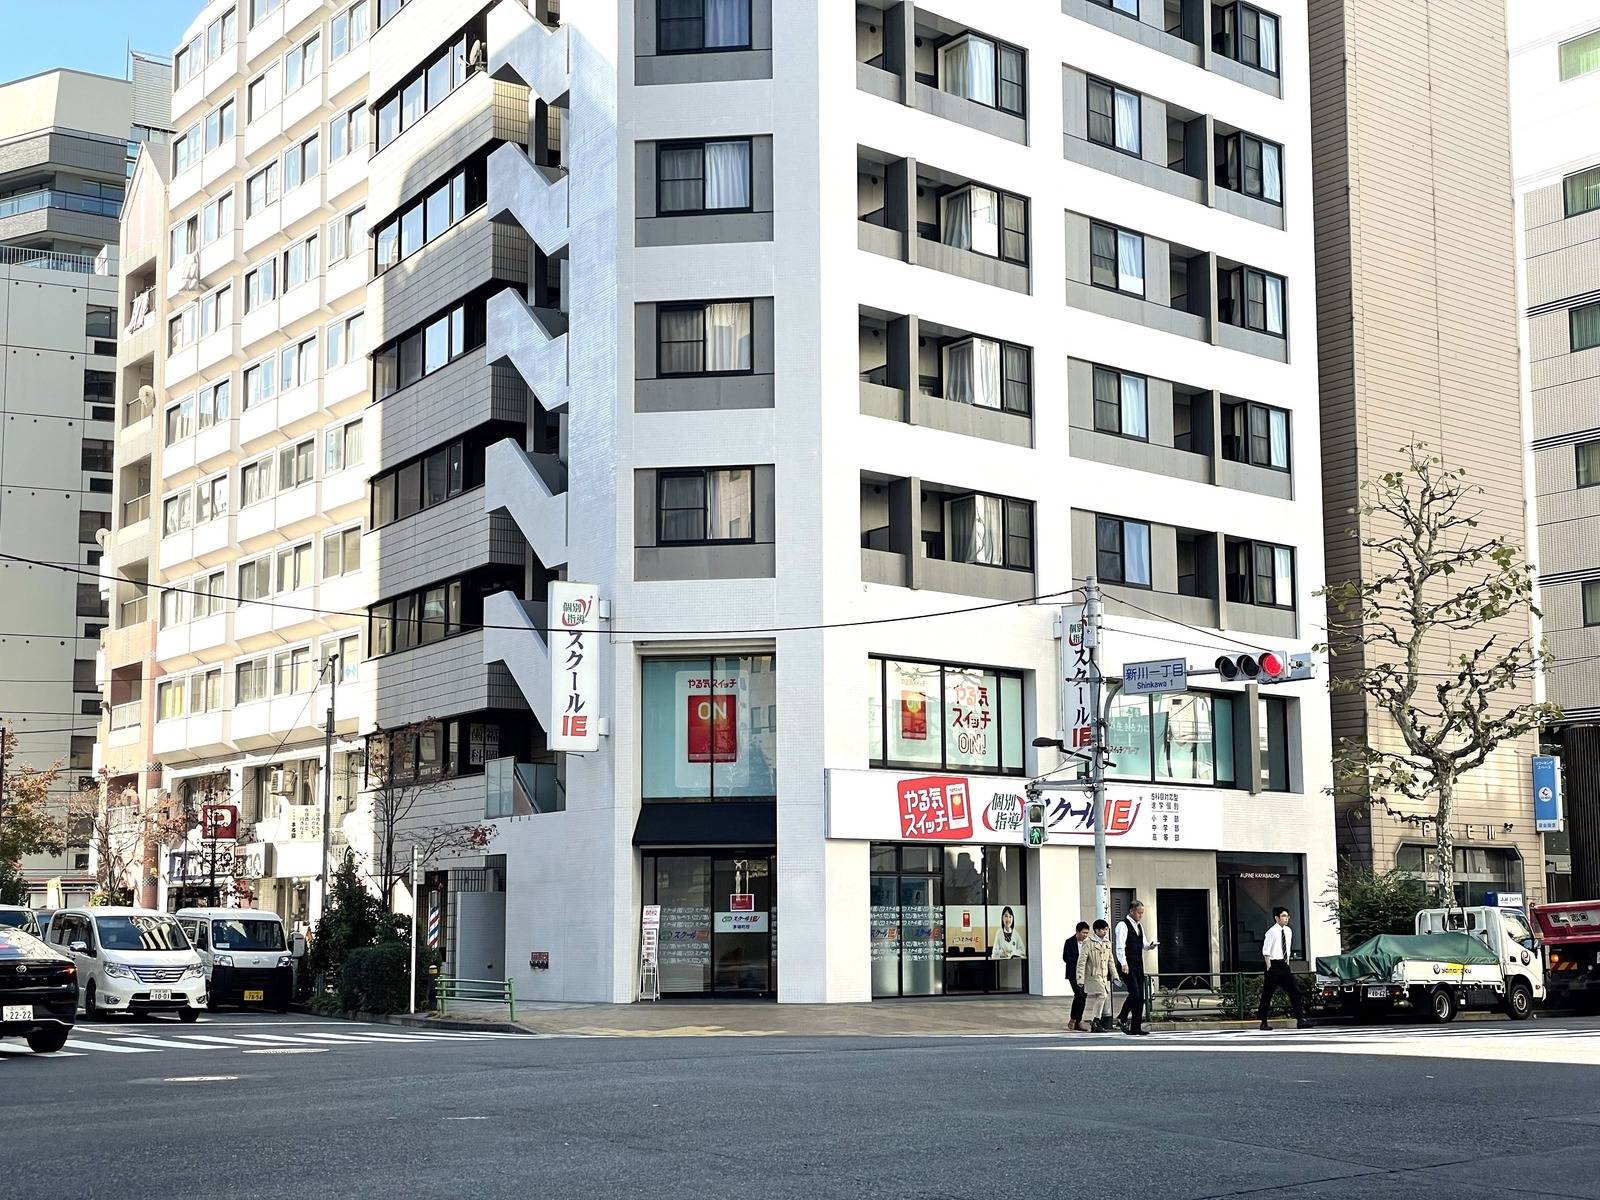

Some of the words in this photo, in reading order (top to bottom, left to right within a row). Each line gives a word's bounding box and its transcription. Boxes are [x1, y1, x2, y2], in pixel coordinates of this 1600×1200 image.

[563, 602, 582, 612] 個別
[567, 614, 586, 624] 指導
[1126, 663, 1184, 682] 新川一丁目
[688, 679, 737, 689] やる気スイッチ
[1137, 681, 1168, 690] Shinkawa
[1170, 679, 1174, 687] 1
[697, 702, 727, 720] ON
[952, 707, 992, 730] スイッチ
[903, 787, 944, 813] やる気
[991, 792, 1017, 811] 個別
[904, 810, 948, 837] スイッチ
[995, 811, 1022, 831] 指導
[10, 1010, 32, 1020] 22-22
